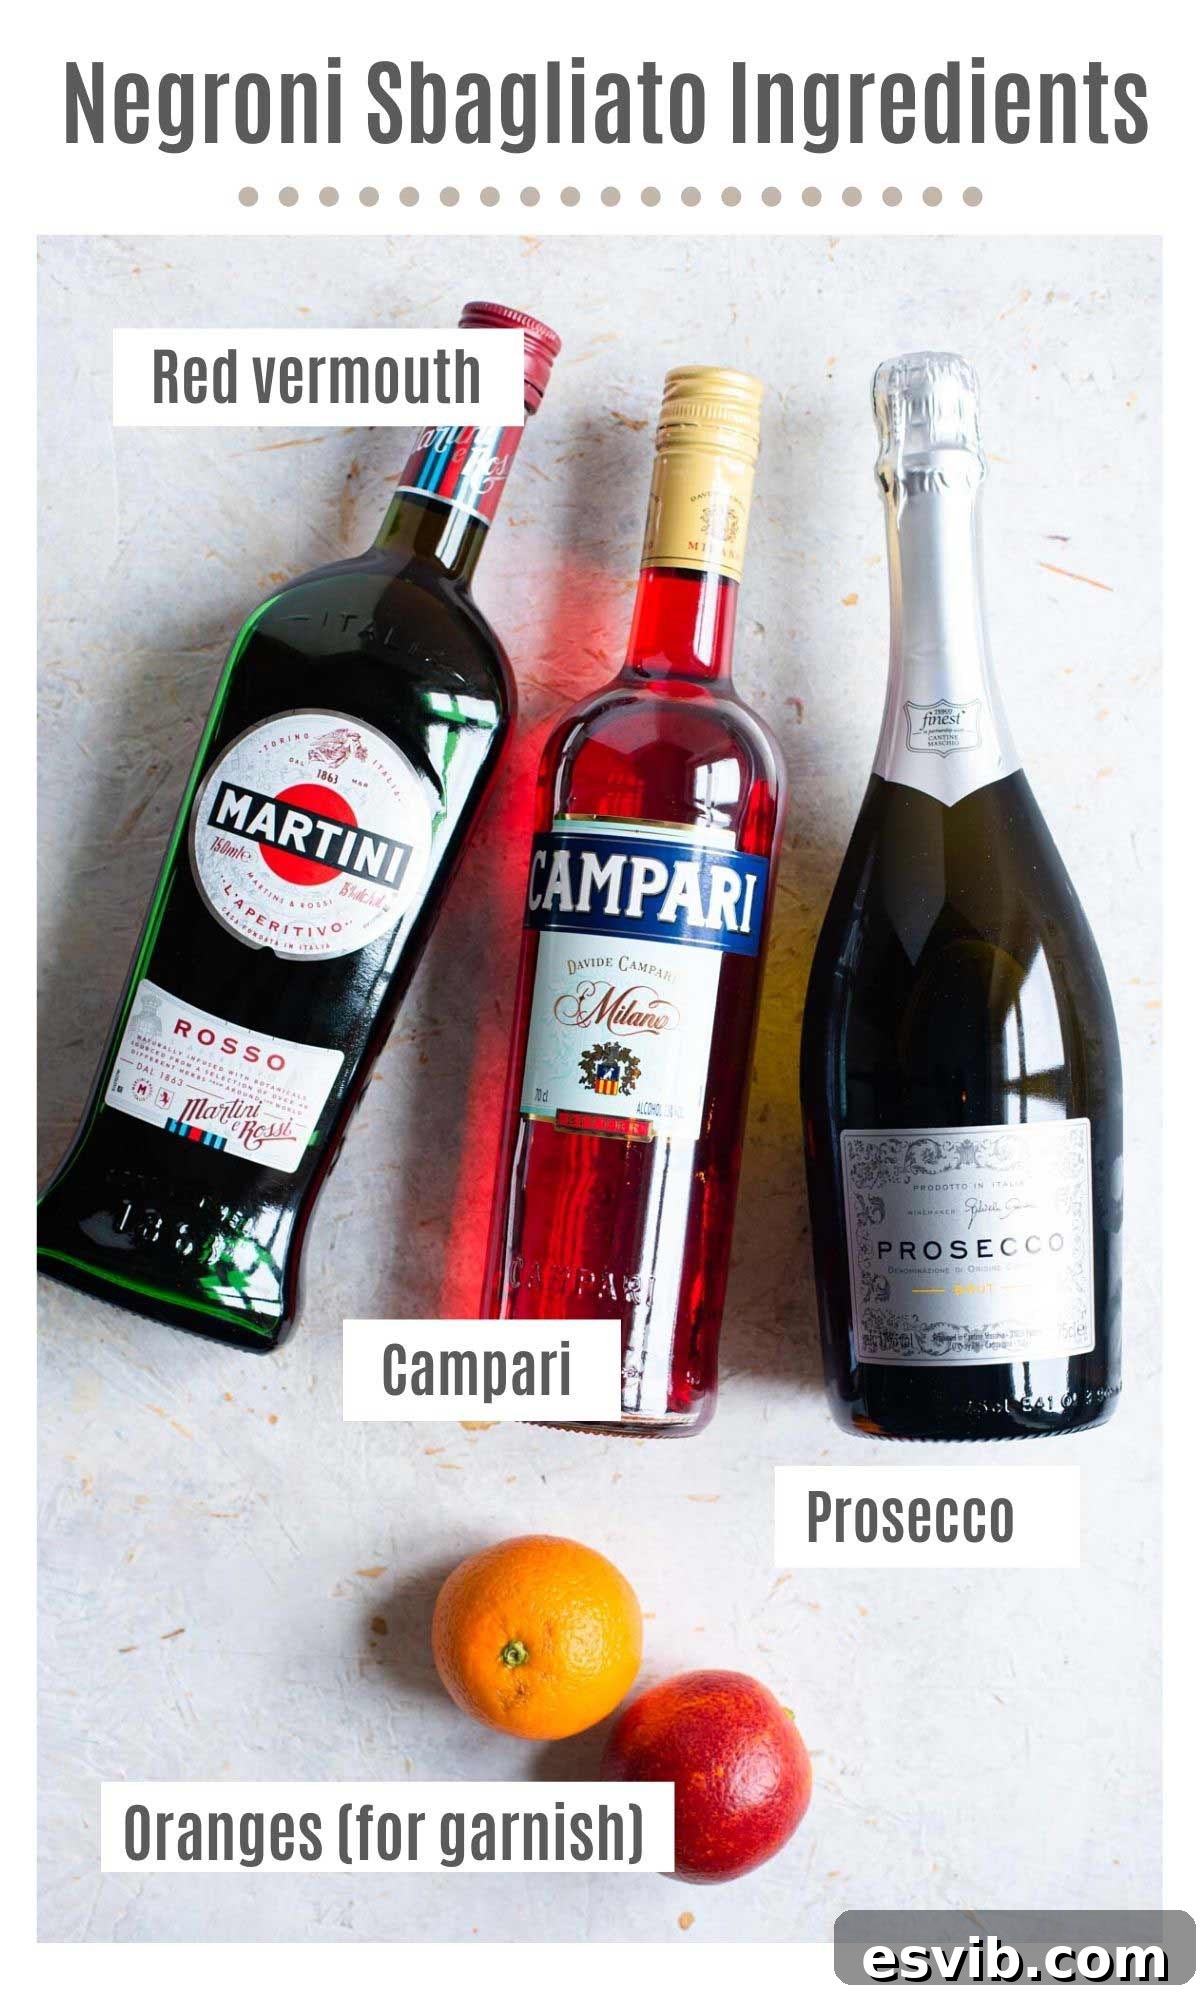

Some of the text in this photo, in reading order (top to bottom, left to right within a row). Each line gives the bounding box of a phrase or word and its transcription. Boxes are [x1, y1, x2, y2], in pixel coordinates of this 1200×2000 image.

[918, 711, 961, 731] finest
[263, 732, 310, 752] TORINO
[316, 768, 340, 785] 1863
[216, 788, 404, 884] MARTINI
[247, 872, 285, 905] MARTINI
[300, 899, 333, 909] ROSSI
[528, 849, 759, 933] CAMPARI
[566, 957, 614, 976] DAVIDE
[553, 979, 682, 1037] Milano
[137, 1034, 183, 1057] NATURALLY
[187, 1054, 224, 1072] INFUSED
[228, 1070, 250, 1081] WITH
[173, 1018, 286, 1072] ROSSO
[136, 1062, 185, 1087] DAL 1863
[169, 1056, 192, 1068] FROM
[204, 1069, 253, 1091] SELECTION
[179, 1068, 206, 1083] HERBS
[136, 1083, 148, 1096] M
[177, 1096, 263, 1125] Martini
[238, 1117, 297, 1151] Rossi
[913, 1183, 968, 1192] PRODOTTO
[973, 1181, 984, 1189] IN
[906, 1208, 956, 1216] WINEMAKER
[877, 1232, 1064, 1260] PROSECCO
